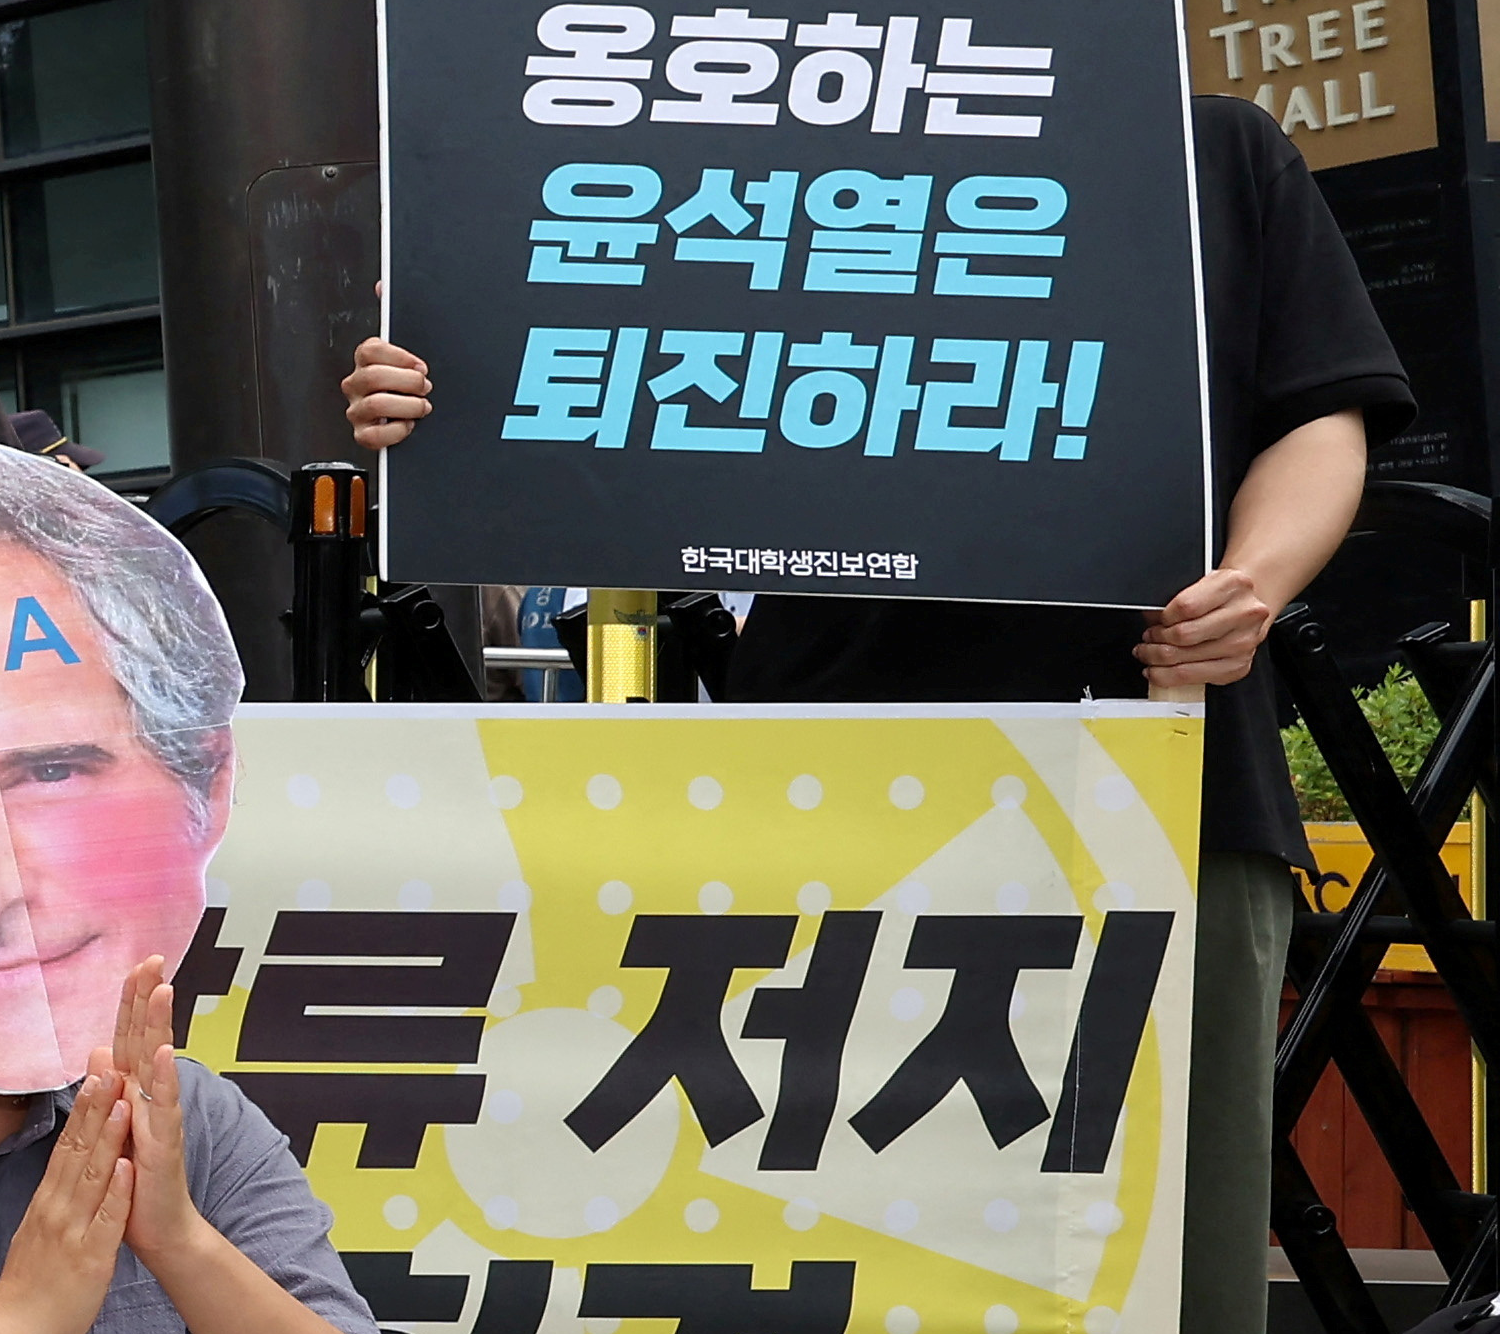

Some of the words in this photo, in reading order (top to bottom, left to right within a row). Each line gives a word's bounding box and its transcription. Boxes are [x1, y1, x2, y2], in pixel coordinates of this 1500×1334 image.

[523, 4, 1055, 137] 옹호하는
[527, 163, 1067, 298] 윤석열은
[501, 327, 1104, 461] 퇴진하라!
[681, 547, 919, 579] 한국대학생진보연합
[172, 907, 518, 1170] 류
[562, 909, 1174, 1173] 저지
